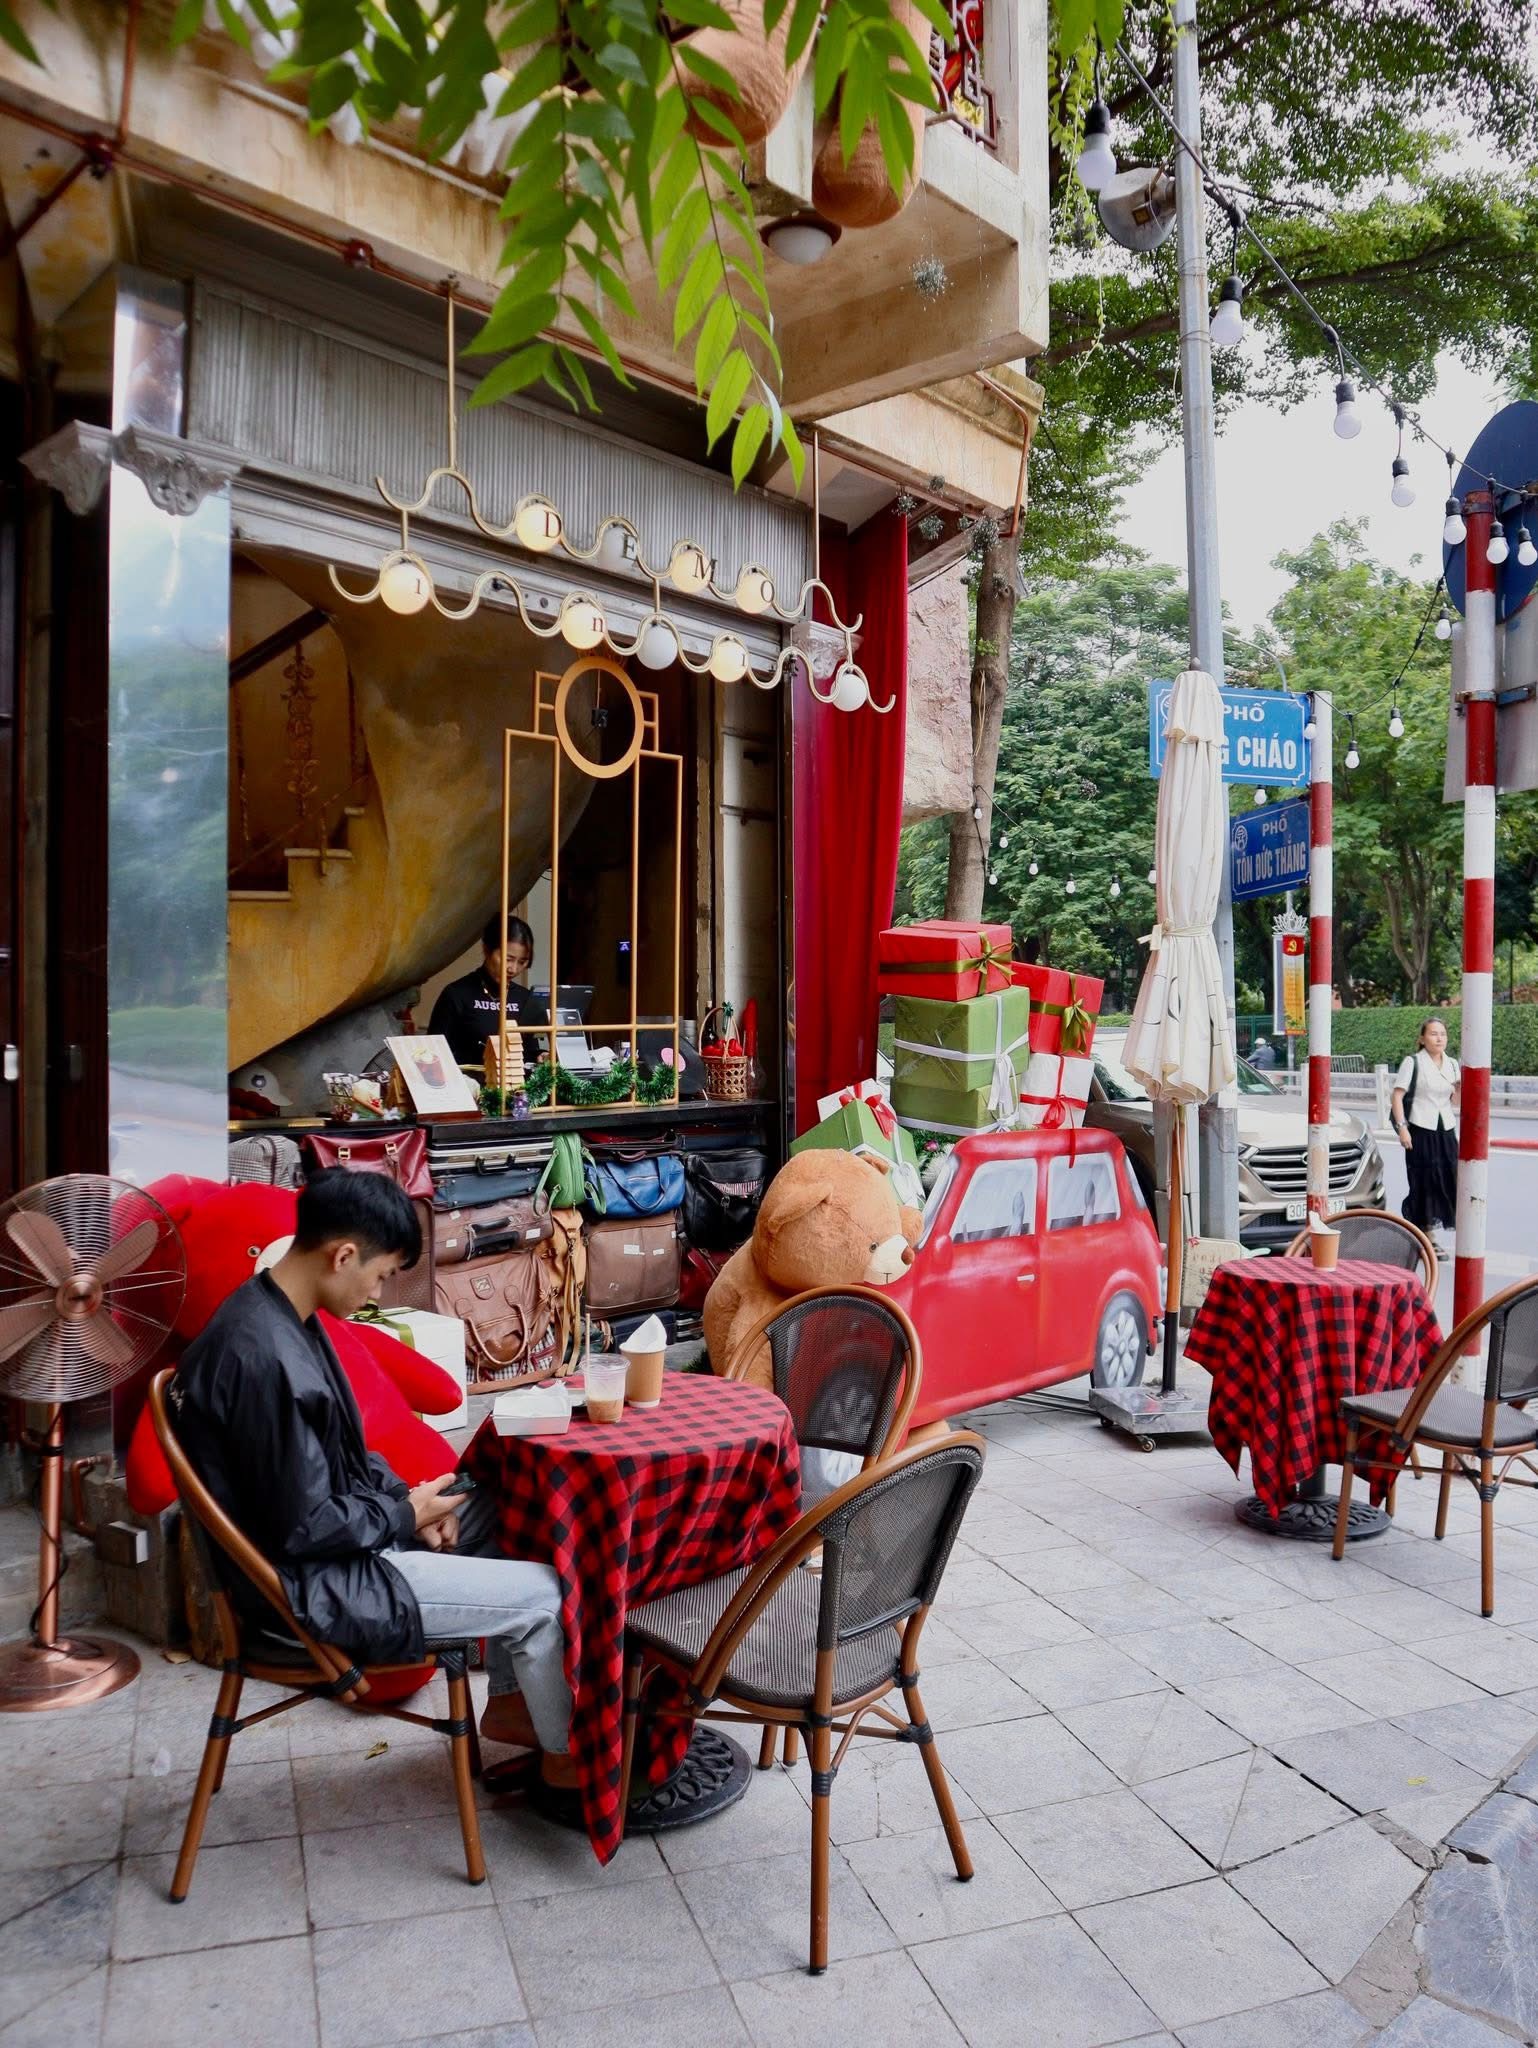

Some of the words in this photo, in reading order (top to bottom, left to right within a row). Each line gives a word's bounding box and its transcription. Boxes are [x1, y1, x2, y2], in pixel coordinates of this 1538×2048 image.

[1224, 700, 1267, 722] PHỐ
[1237, 733, 1297, 769] CHÁO
[1262, 810, 1288, 836] PHỐ
[1236, 852, 1253, 885] TÔN
[1256, 845, 1273, 881] ĐỨC
[1275, 834, 1306, 877] THẮNG
